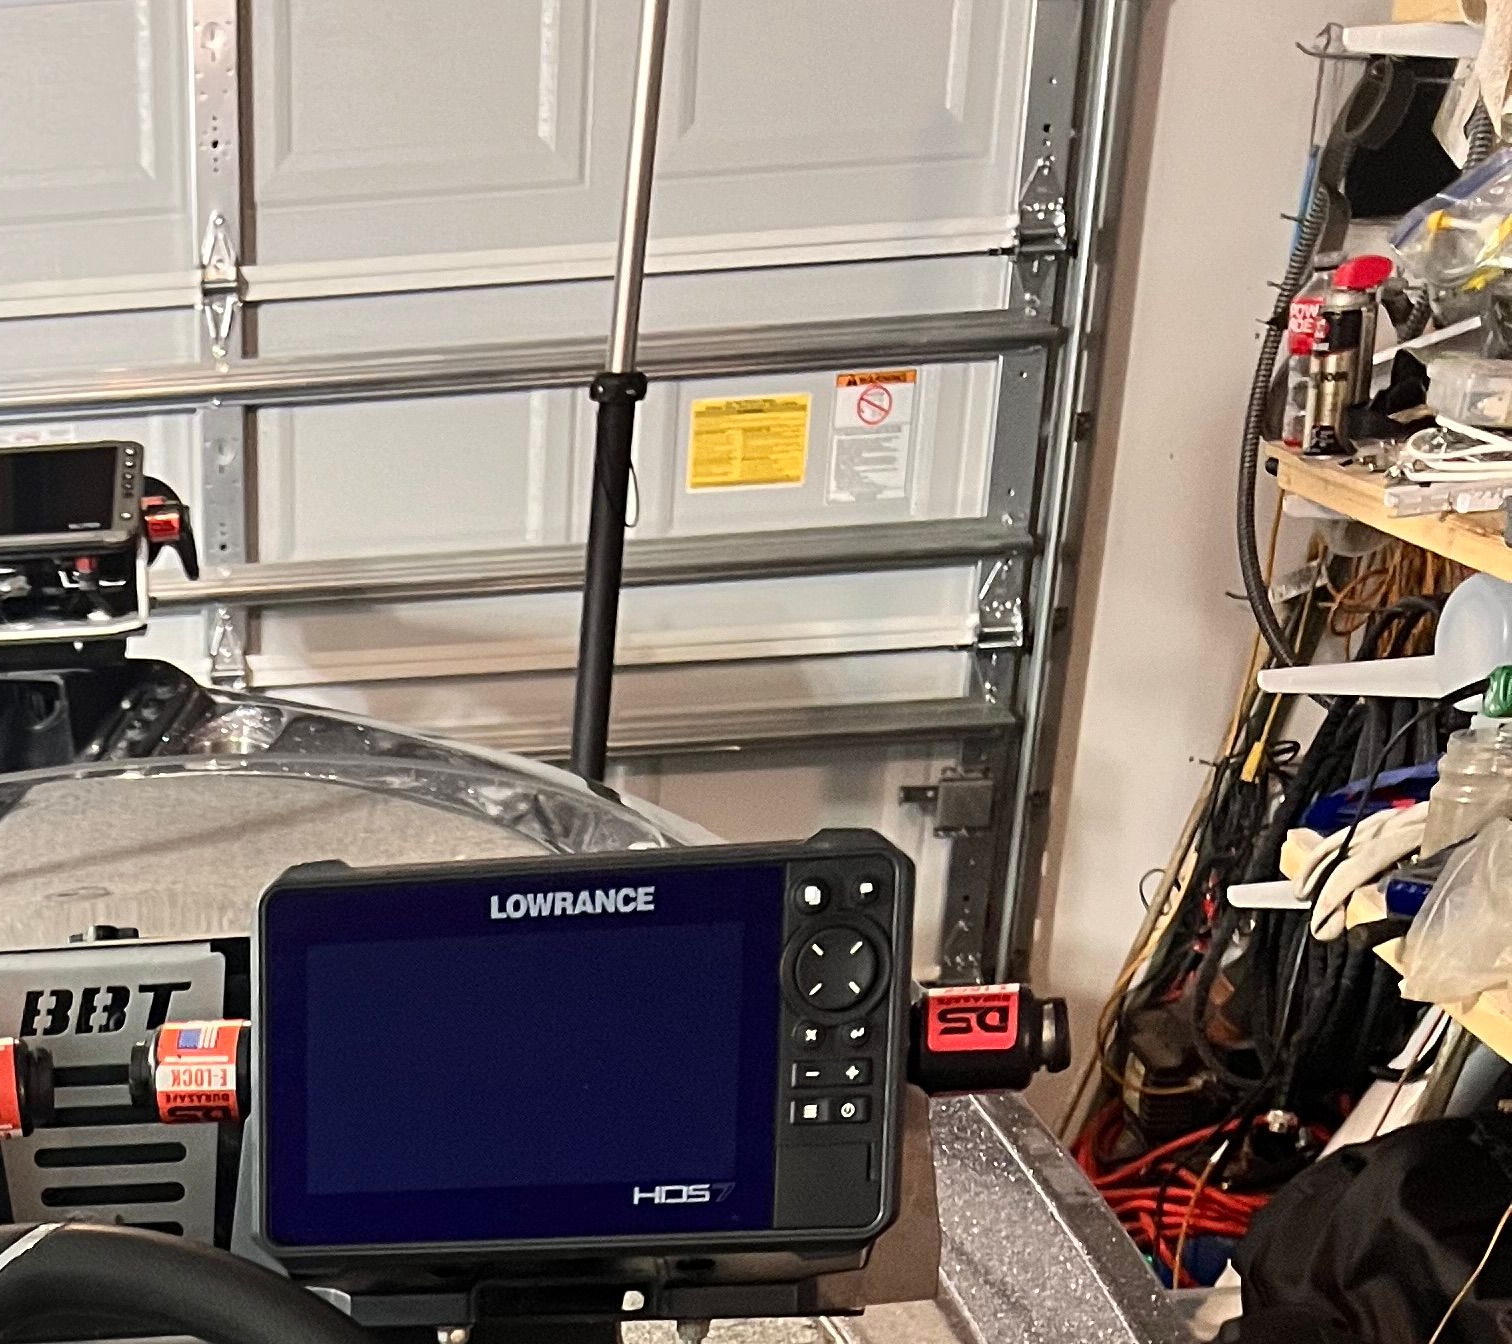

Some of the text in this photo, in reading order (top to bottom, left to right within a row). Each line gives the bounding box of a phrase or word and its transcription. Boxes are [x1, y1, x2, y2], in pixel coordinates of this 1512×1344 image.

[490, 886, 656, 919] LOWRANCE
[20, 981, 192, 1037] BBT
[937, 1005, 1010, 1035] DS
[171, 1068, 227, 1087] E-LOCK
